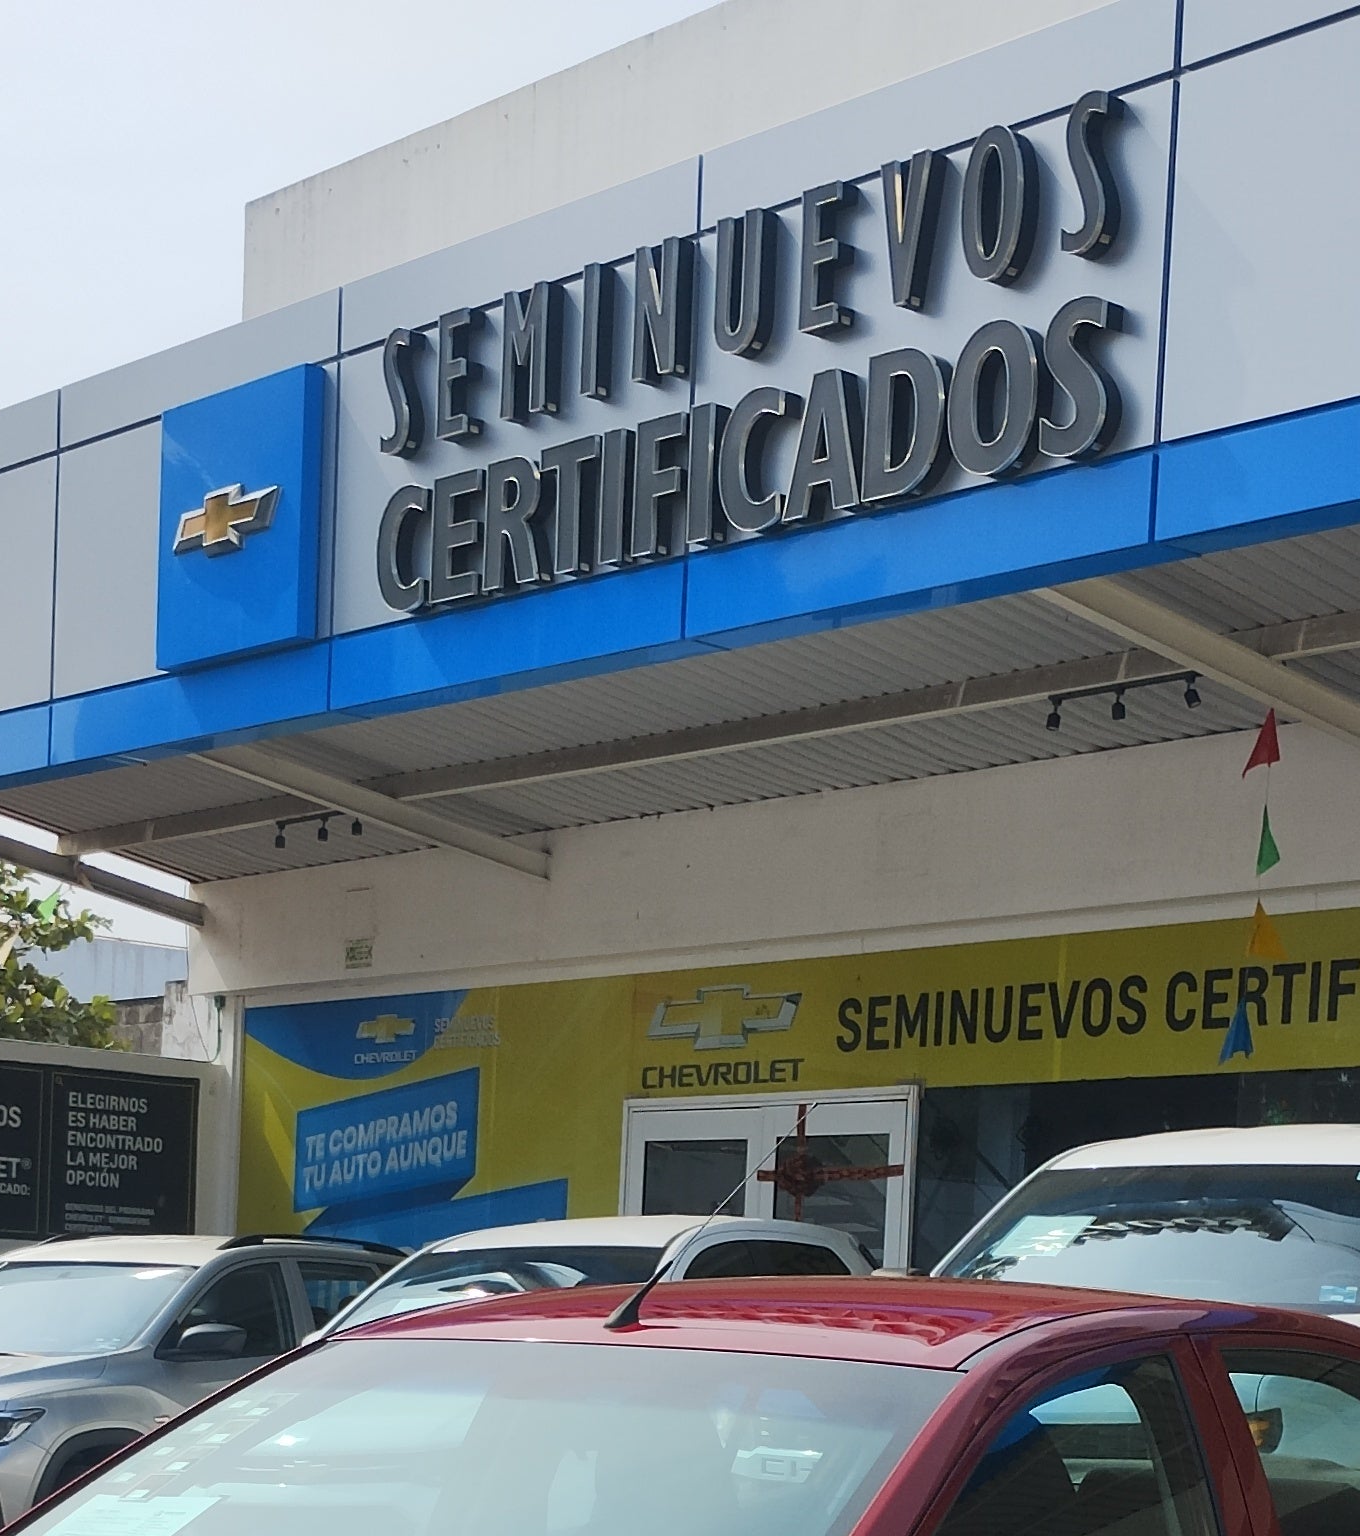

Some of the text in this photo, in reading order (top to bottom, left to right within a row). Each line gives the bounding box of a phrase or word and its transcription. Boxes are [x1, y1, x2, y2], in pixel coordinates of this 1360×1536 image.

[378, 89, 1124, 458] SEMINUEVOS
[376, 295, 1124, 615] CERTIFICADOS
[835, 974, 1148, 1053] SEMINUEVOS
[354, 1050, 417, 1065] CHEVROLET
[641, 1057, 806, 1090] CHEVROLET
[68, 1092, 148, 1114] ELEGIRNOS
[68, 1112, 137, 1132] ES HABER
[305, 1101, 458, 1163] TE COMPRAMOS
[67, 1131, 163, 1153] ENCONTRADO
[66, 1150, 138, 1170] LA MEJOR
[303, 1130, 468, 1193] TU AUTO AUNQUE
[66, 1168, 120, 1189] OPCIÓN
